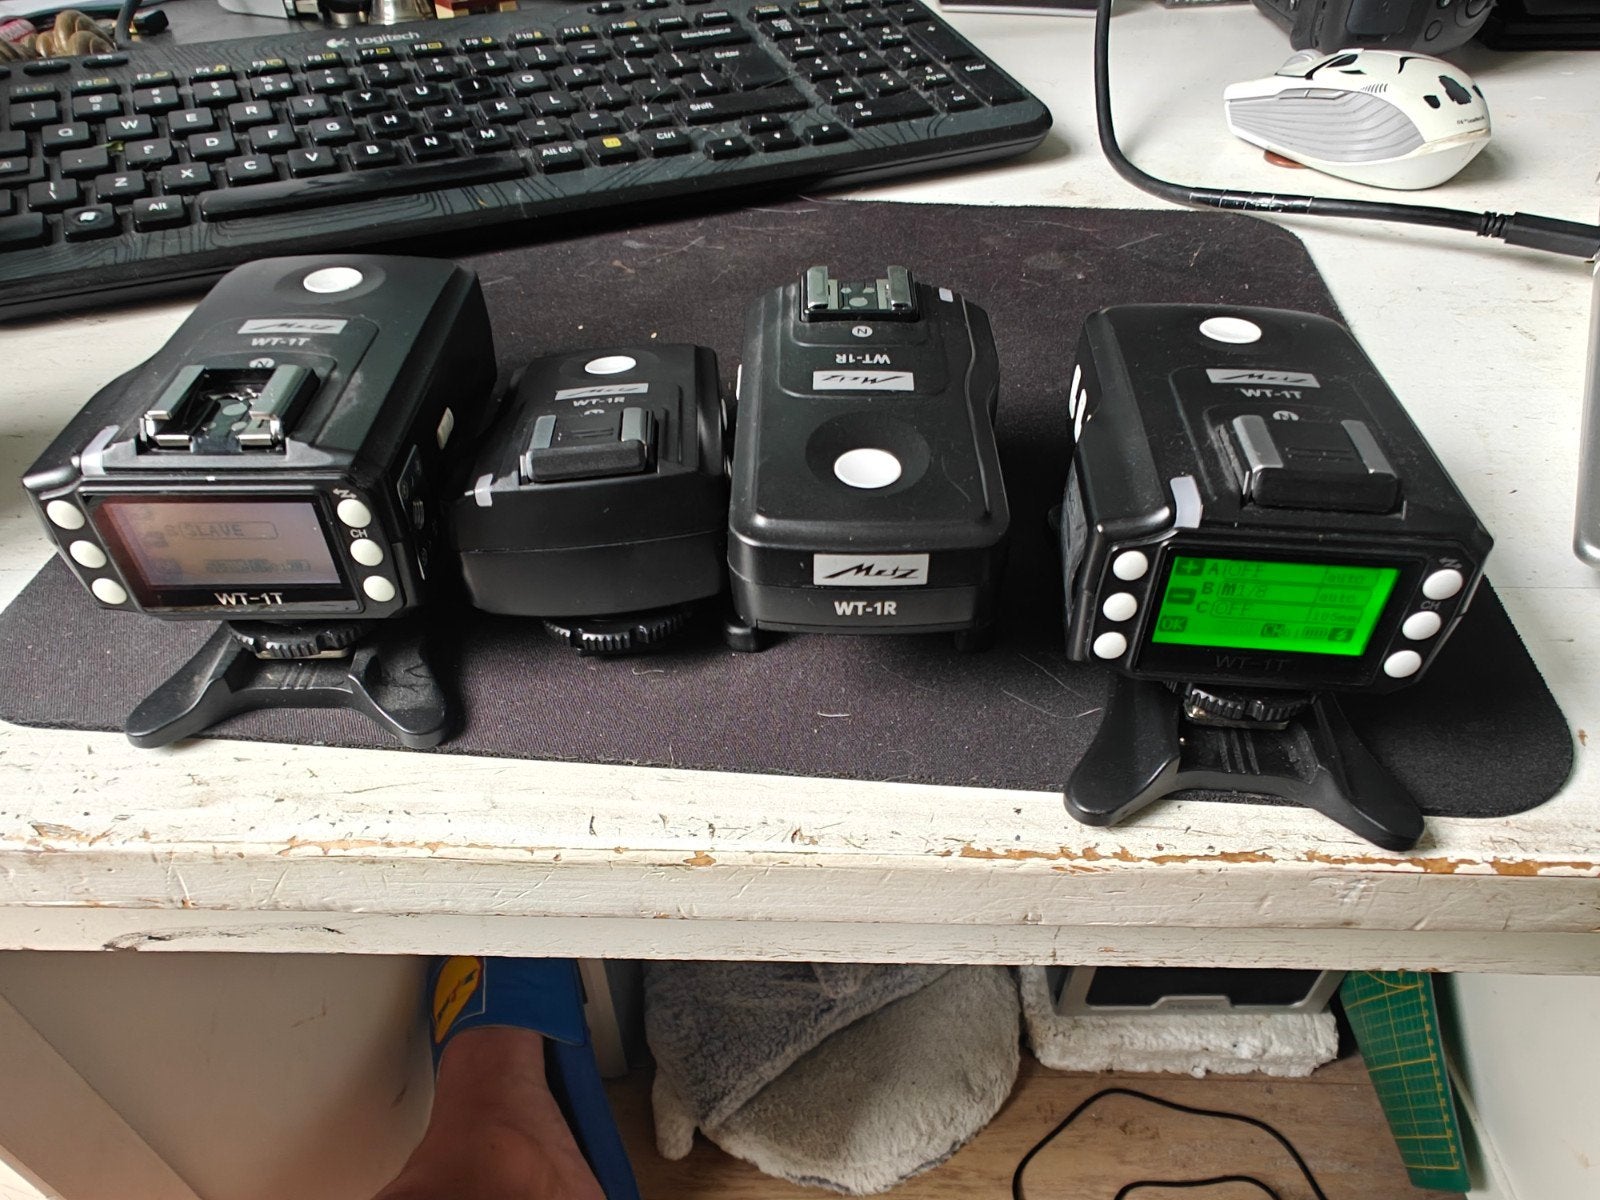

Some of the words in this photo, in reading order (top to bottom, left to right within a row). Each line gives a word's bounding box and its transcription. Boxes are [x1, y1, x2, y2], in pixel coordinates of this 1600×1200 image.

[681, 28, 731, 38] Backspace
[355, 32, 420, 45] Logitech
[690, 102, 714, 111] Shift
[384, 115, 398, 124] H
[120, 120, 138, 130] W
[480, 129, 496, 138] M
[656, 131, 676, 140] Ctrl
[206, 138, 218, 146] D
[424, 136, 439, 146] N
[181, 168, 194, 178] X
[148, 202, 167, 211] Alt
[251, 338, 311, 346] WT-1T
[836, 354, 891, 365] WT-1R
[1240, 388, 1302, 400] WT-1T
[350, 529, 368, 538] CH
[822, 563, 920, 580] Metz
[214, 592, 283, 606] WT-1T
[834, 601, 898, 616] WT-1R
